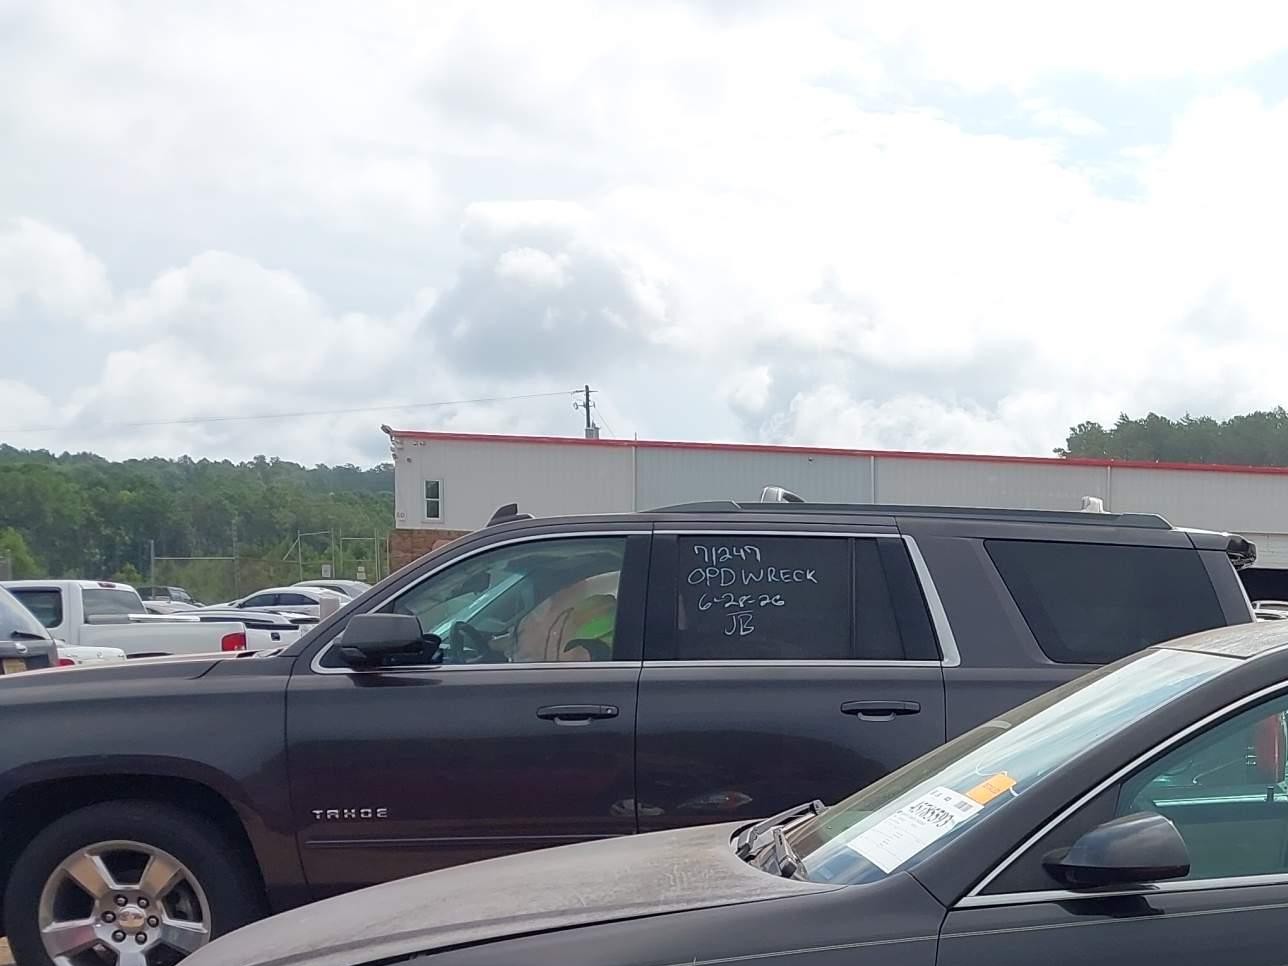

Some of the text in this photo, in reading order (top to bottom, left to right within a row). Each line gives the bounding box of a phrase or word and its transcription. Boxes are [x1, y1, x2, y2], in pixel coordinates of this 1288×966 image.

[694, 545, 761, 563] 71247
[687, 566, 819, 587] OPD WRECK
[698, 592, 785, 611] 6-28-26
[724, 610, 755, 636] JB
[311, 808, 388, 820] TAHOE
